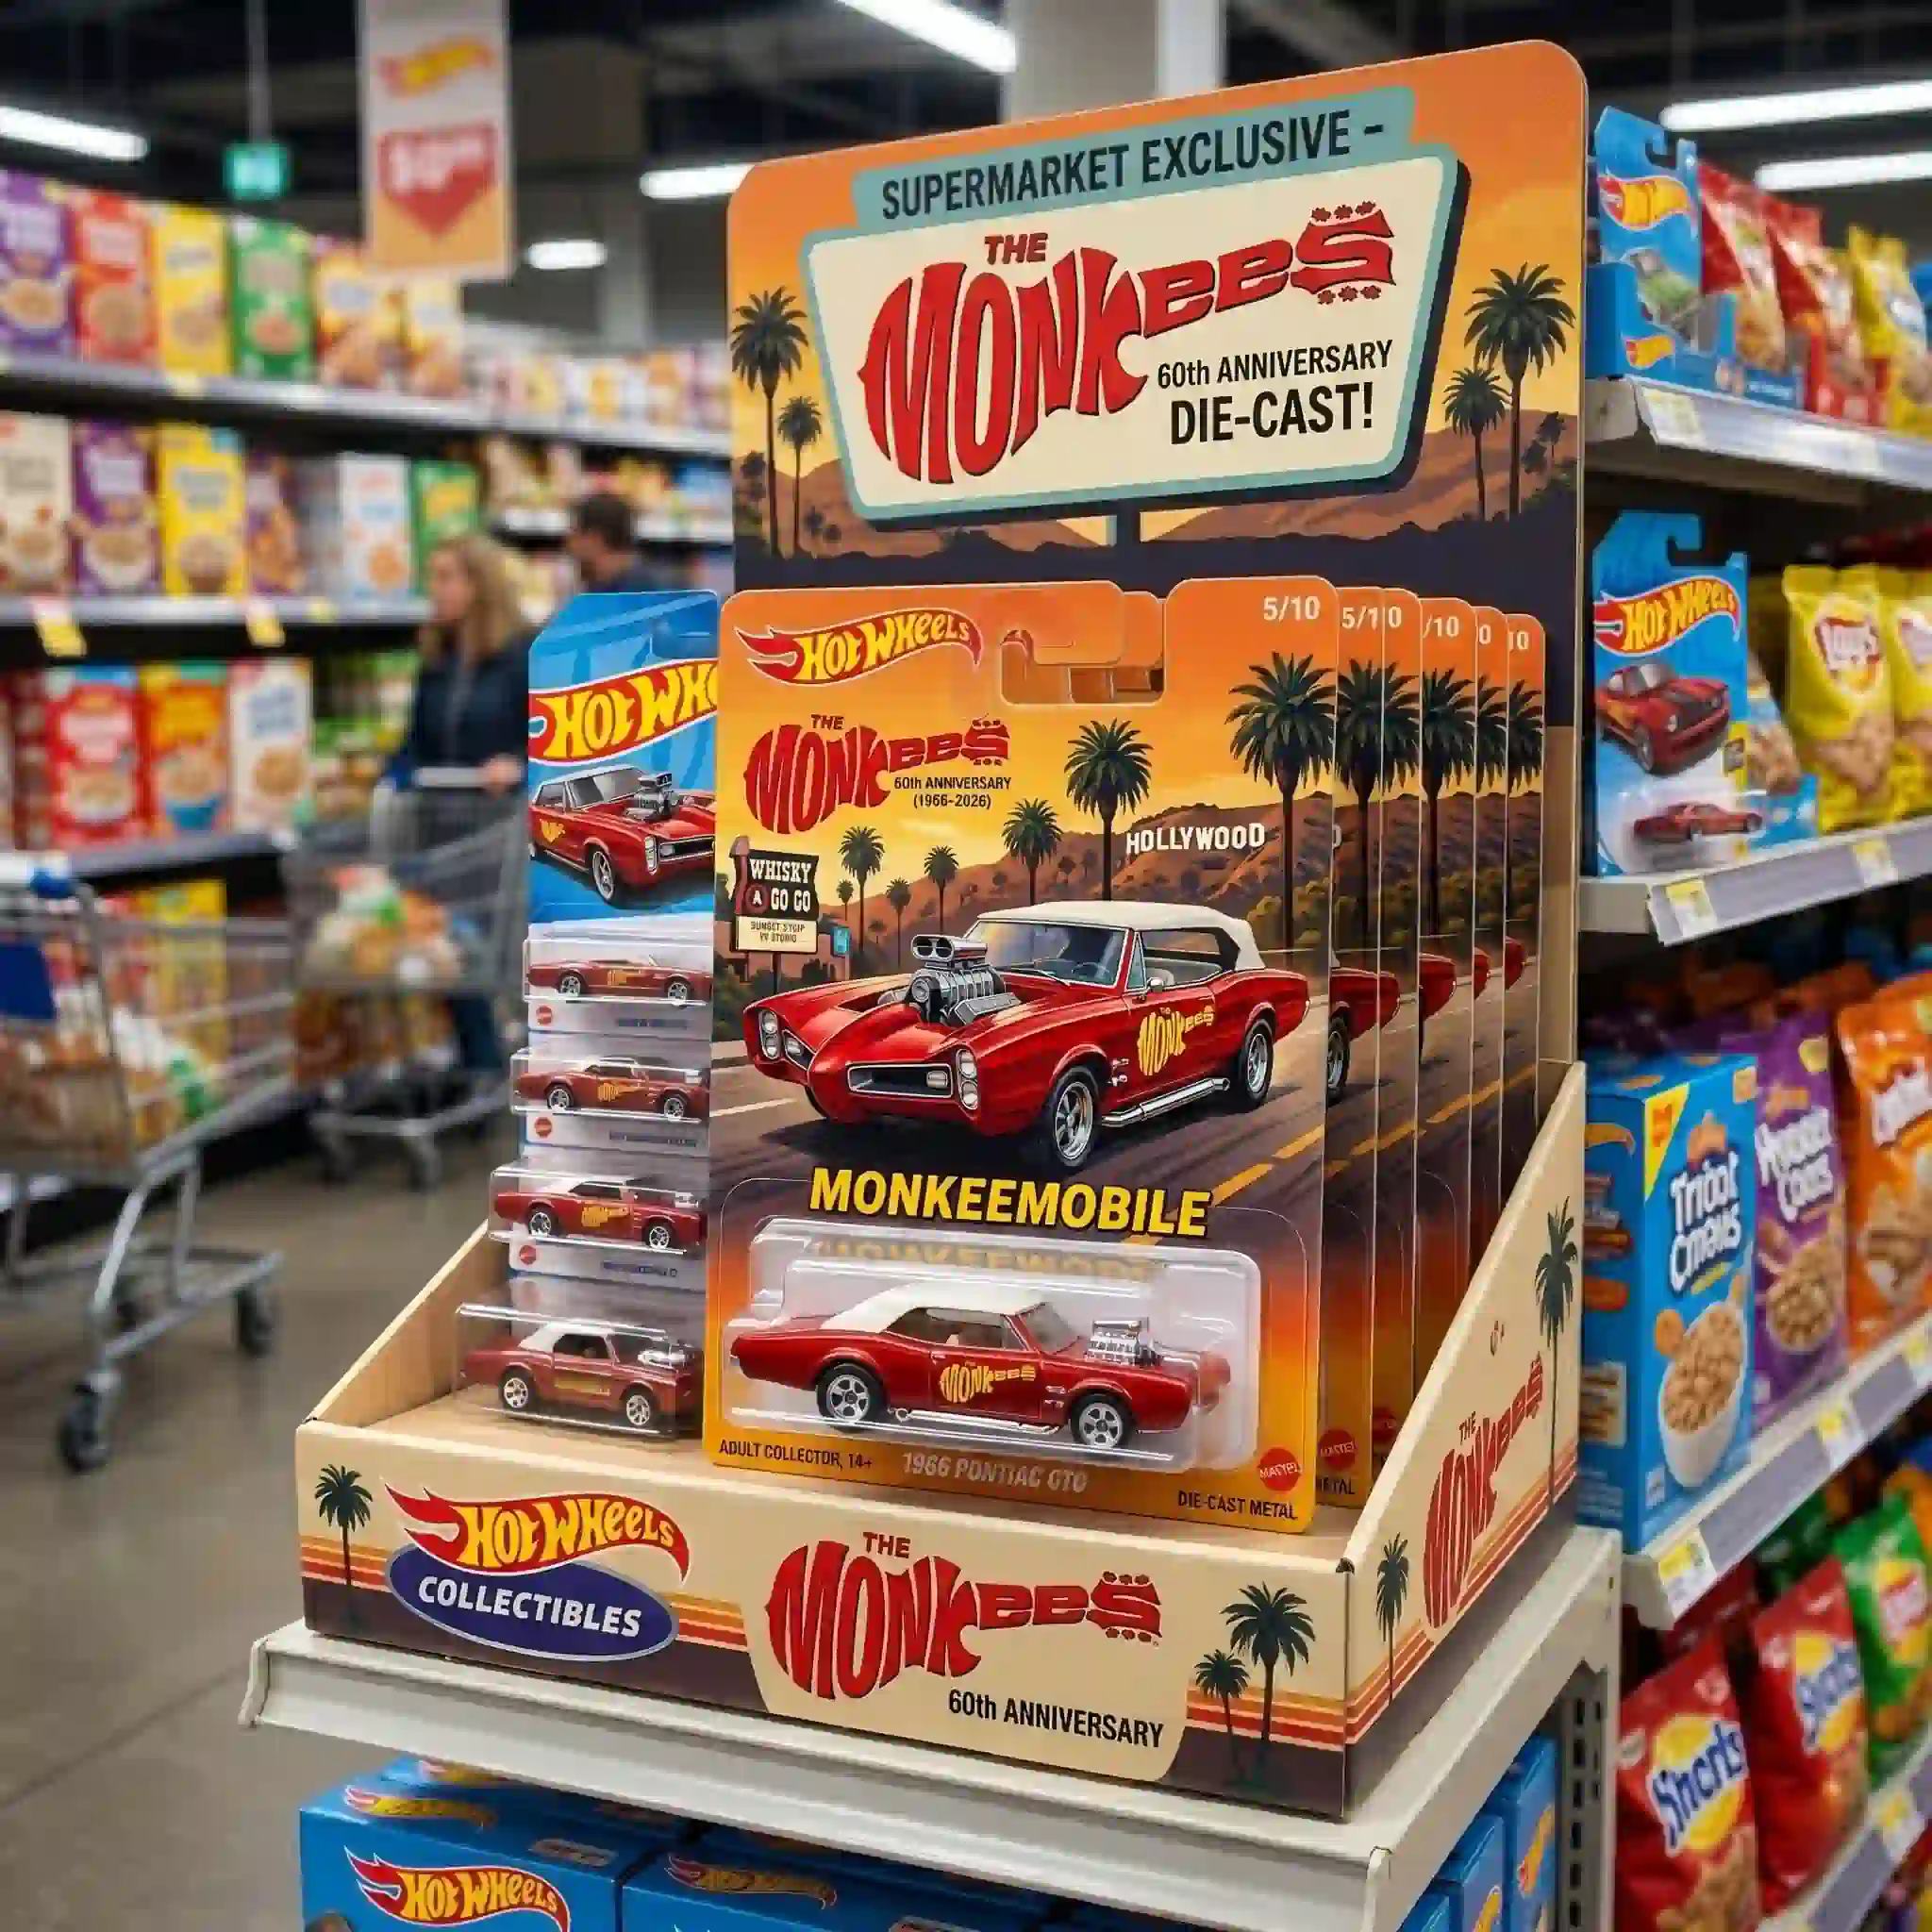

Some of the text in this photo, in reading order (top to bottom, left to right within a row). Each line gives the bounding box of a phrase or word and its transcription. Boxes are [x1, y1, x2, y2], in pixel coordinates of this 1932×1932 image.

[882, 142, 1129, 220] SUPERMARKET
[1141, 110, 1351, 183] EXCLUSIVE
[984, 232, 1049, 266] THE
[1158, 340, 1393, 390] 60th ANNIVERSARY
[1169, 382, 1374, 446] DIE-CAST!
[1263, 594, 1321, 623] 5/10
[1341, 605, 1381, 630] 5/1
[1423, 614, 1460, 639] /10
[793, 632, 863, 680] HOT
[536, 689, 636, 759] HOT
[810, 713, 845, 731] THE
[893, 775, 1012, 791] 60th ANNIVERSARY
[913, 793, 992, 810] (1966-2026)
[1125, 822, 1267, 856] HOLLYWOOD
[749, 858, 811, 884] WHISKY
[753, 890, 762, 906] A
[771, 887, 788, 911] GO
[808, 1166, 1213, 1238] MONKEEMOBILE
[1458, 1410, 1477, 1446] THE
[719, 1438, 874, 1471] ADULT COLLECTOR, 14+
[902, 1452, 1089, 1494] 1966 PONTIAC GTO
[1178, 1489, 1299, 1521] DIE-CAST METAL
[450, 1504, 541, 1569] HOT
[862, 1530, 911, 1559] THE
[418, 1575, 642, 1638] COLLECTIBLES
[948, 1688, 1164, 1748] 60th ANNIVERSARY
[398, 1868, 461, 1923] HOT
